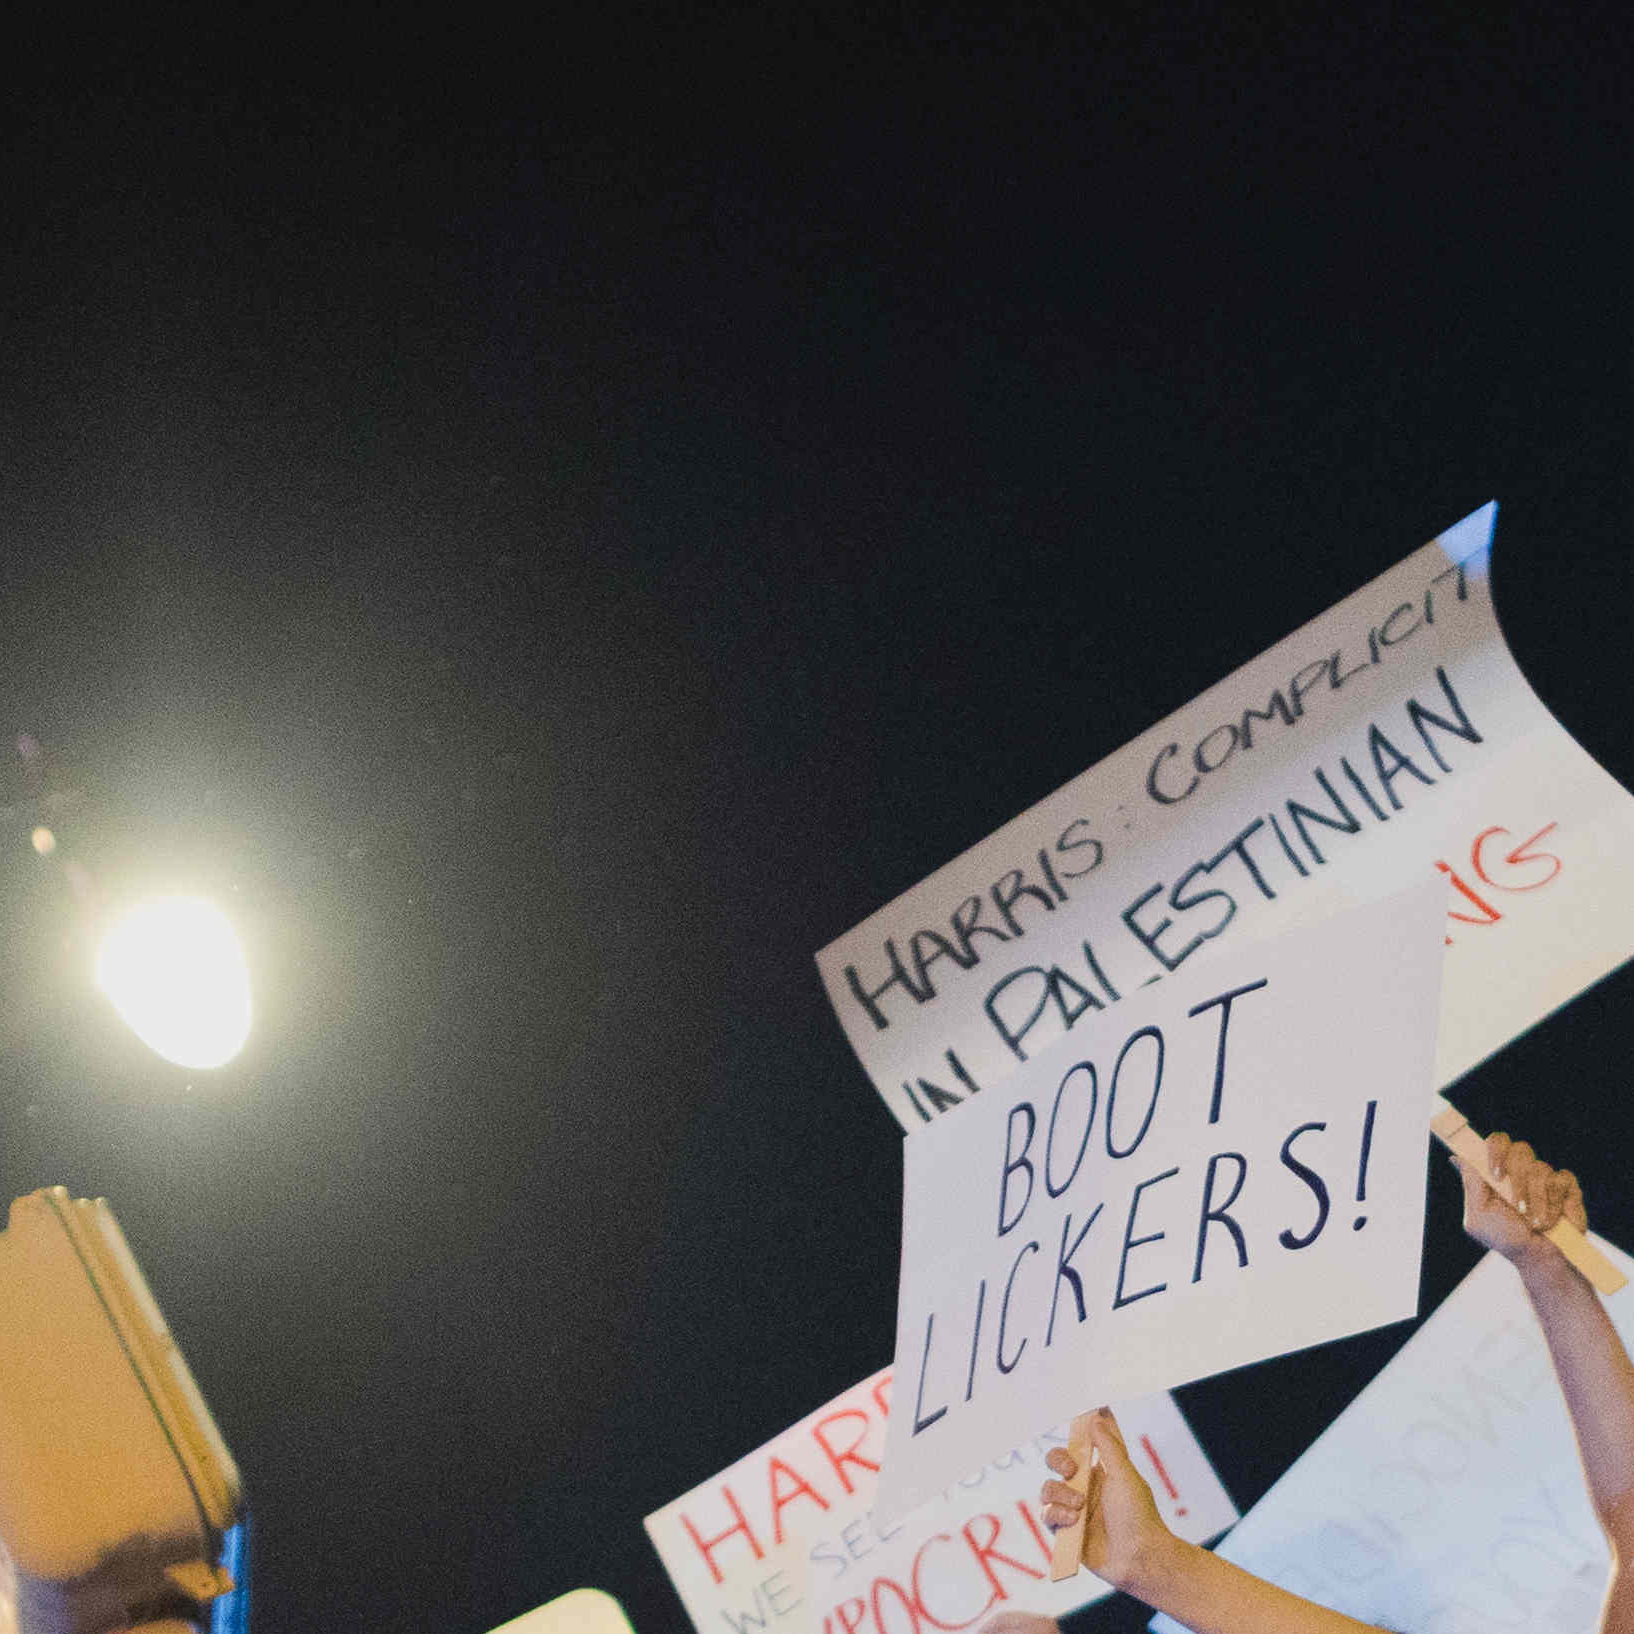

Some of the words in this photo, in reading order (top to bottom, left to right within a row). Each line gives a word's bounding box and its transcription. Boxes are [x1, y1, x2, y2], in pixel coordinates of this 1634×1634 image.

[902, 1046, 981, 1124] IN
[983, 665, 1484, 1062] PALESTINIAN
[911, 1099, 1378, 1440] LICKERS!
[996, 976, 1269, 1238] BOOT
